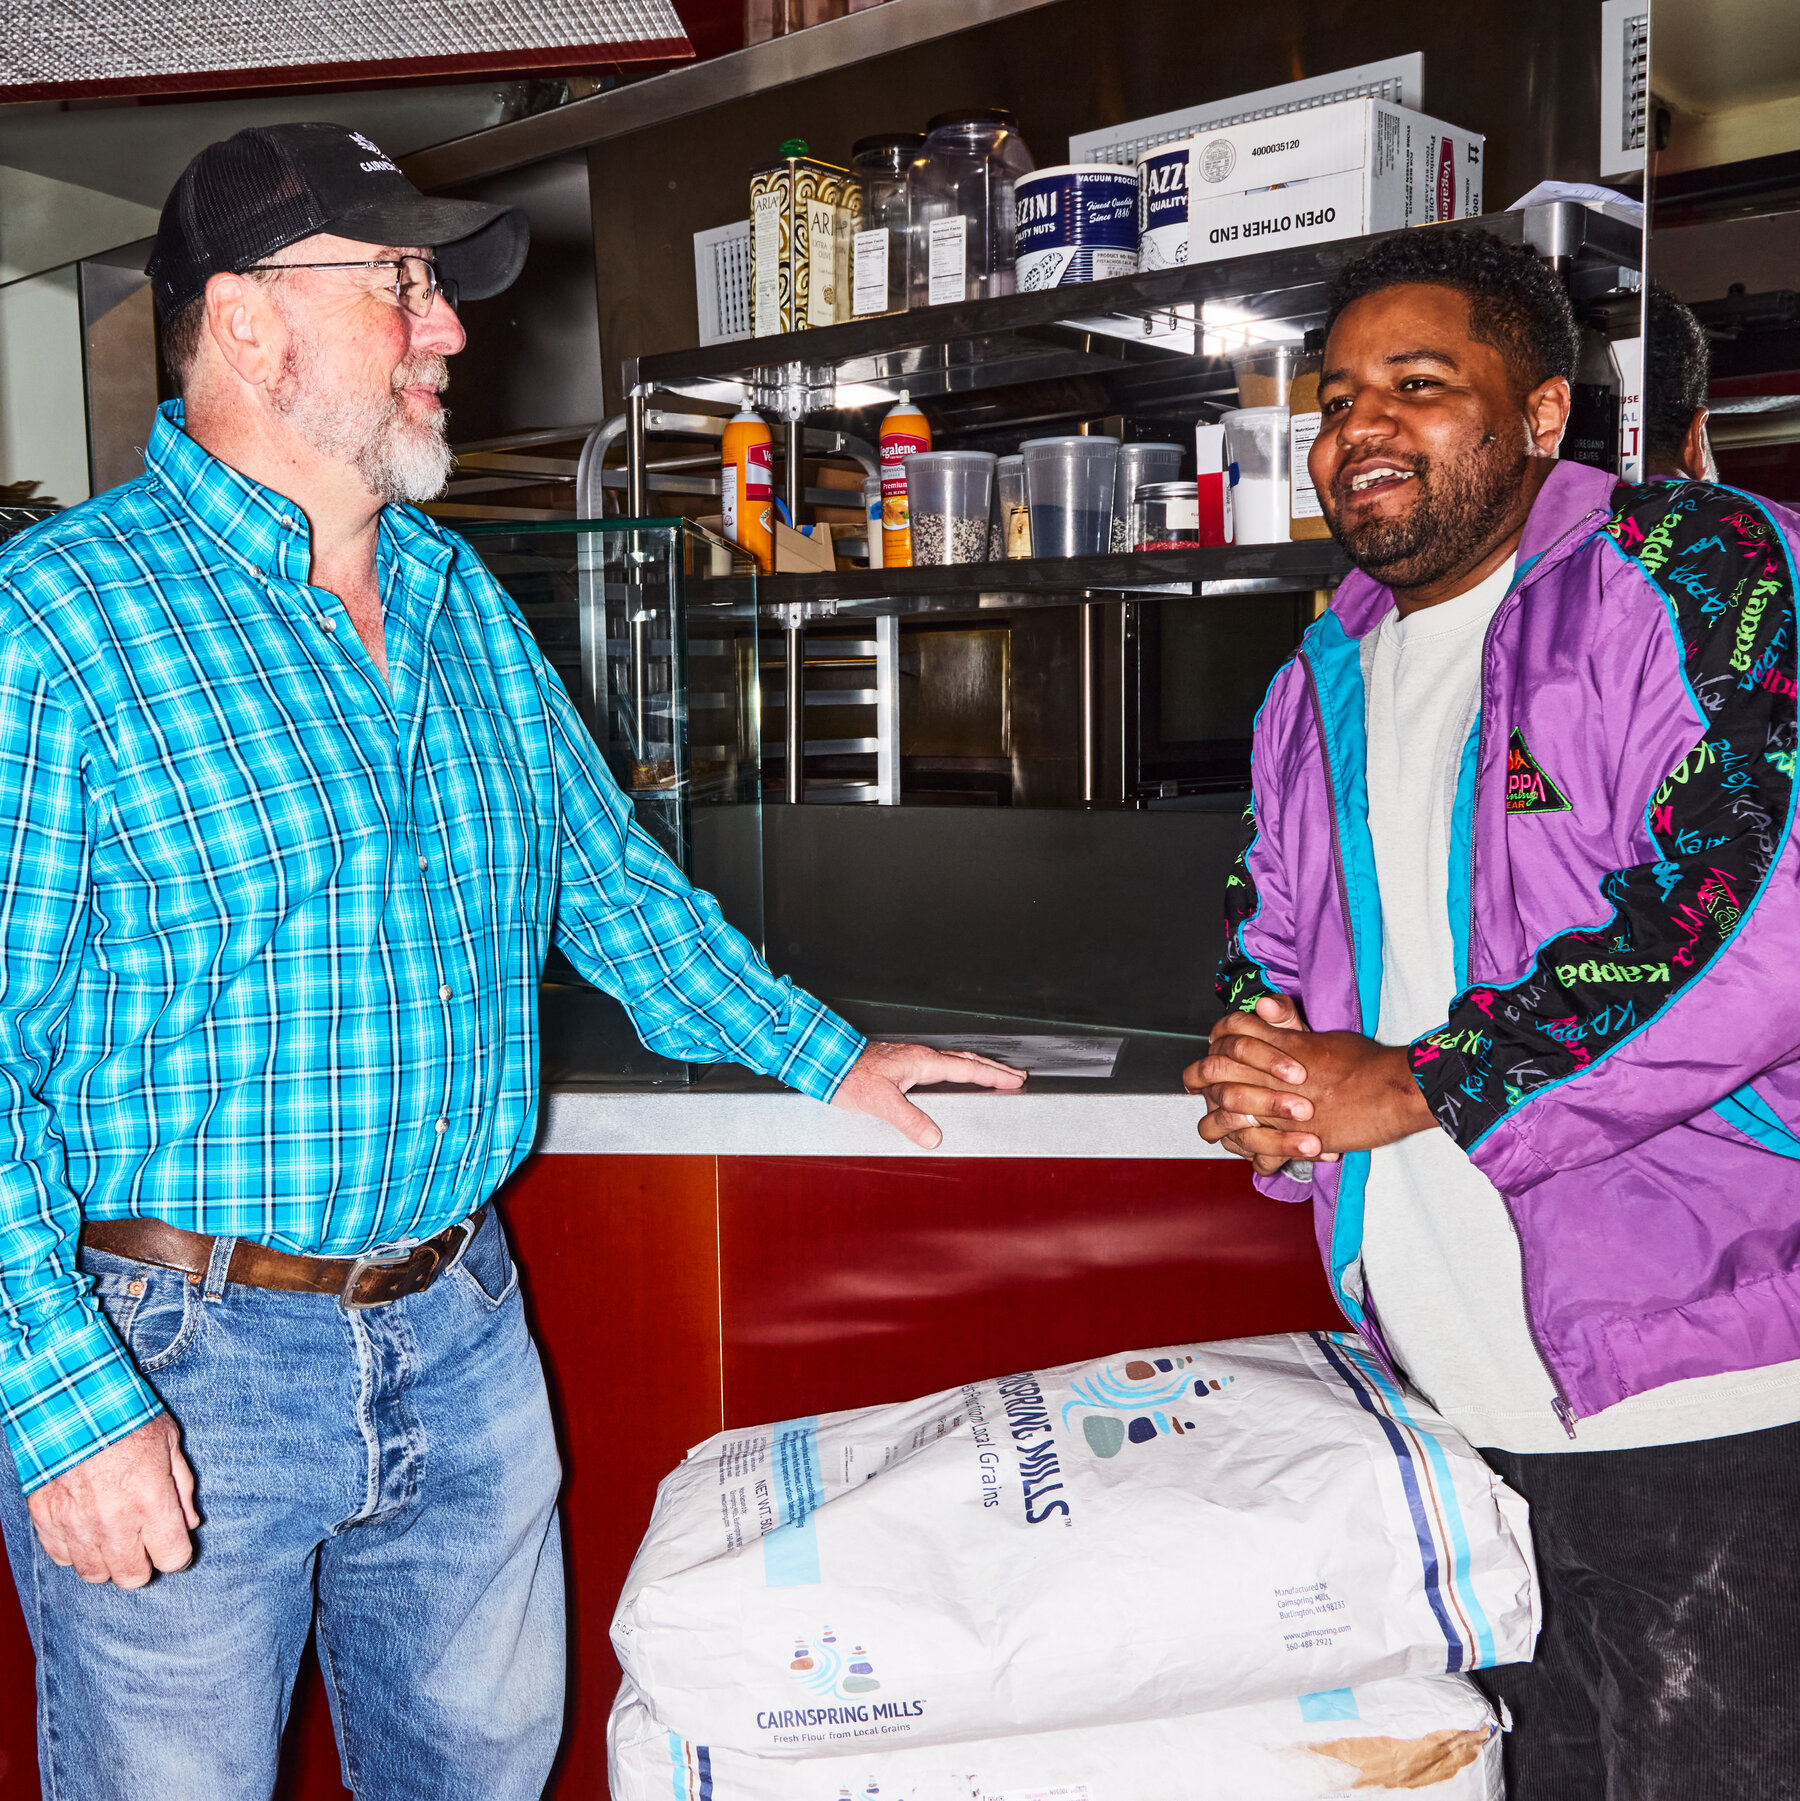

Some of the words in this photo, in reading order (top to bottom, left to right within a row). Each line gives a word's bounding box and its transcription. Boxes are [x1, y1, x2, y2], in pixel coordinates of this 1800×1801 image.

[1252, 139, 1300, 157] 4000035120
[1079, 175, 1112, 183] VACUUM
[1086, 201, 1110, 211] Finest
[1112, 196, 1133, 208] Quality
[1150, 195, 1188, 213] QUALITY
[1089, 212, 1112, 224] Since
[1114, 207, 1130, 219] 1886
[1295, 207, 1336, 230] OPEN
[1033, 222, 1056, 236] NUTS
[1242, 215, 1291, 238] OTHER
[1209, 227, 1239, 244] END
[1574, 440, 1605, 449] OREGANO
[1574, 452, 1599, 461] LEAVES
[883, 481, 908, 490] Premium
[972, 1421, 990, 1448] Local
[979, 1452, 1003, 1508] Grains
[754, 1479, 768, 1499] NET
[757, 1500, 772, 1519] WT.
[760, 1518, 772, 1528] 50
[1274, 1583, 1319, 1597] Manufactured
[1277, 1596, 1314, 1609] Cairnspring
[1279, 1608, 1316, 1620] Burlington,
[1315, 1604, 1327, 1614] WA
[1283, 1624, 1352, 1641] www.cairnspring.com
[1286, 1637, 1333, 1652] 360-488-2921
[756, 1705, 869, 1730] CAIRNSPRING
[773, 1733, 799, 1743] Fresh
[802, 1732, 826, 1742] Flour
[829, 1729, 851, 1740] from
[853, 1726, 879, 1737] Local
[881, 1723, 911, 1734] Grains
